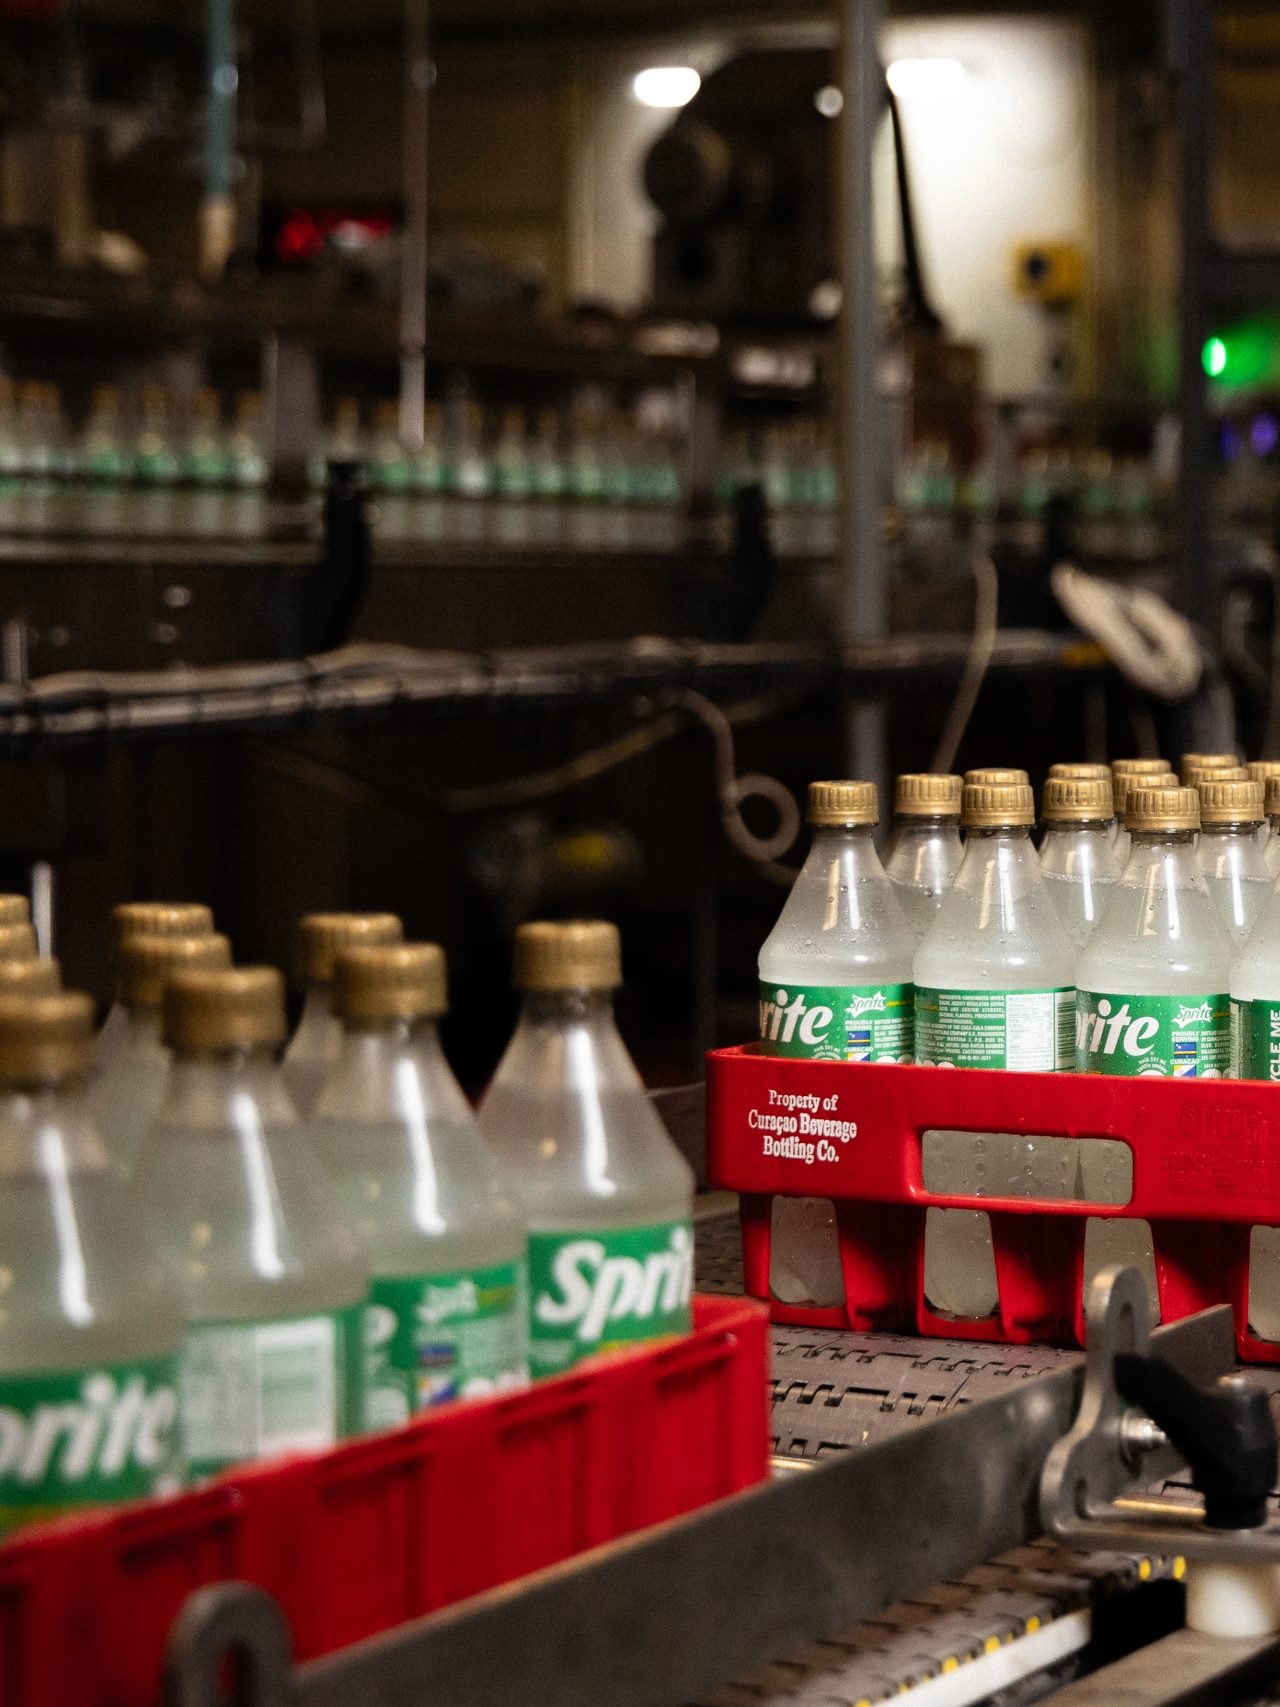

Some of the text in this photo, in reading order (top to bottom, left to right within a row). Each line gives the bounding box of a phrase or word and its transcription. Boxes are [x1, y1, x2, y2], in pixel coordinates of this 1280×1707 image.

[759, 989, 834, 1045] rite
[768, 1089, 839, 1113] Property of
[748, 1109, 858, 1143] Curaçao Beverage
[763, 1135, 840, 1164] Bottling Co.
